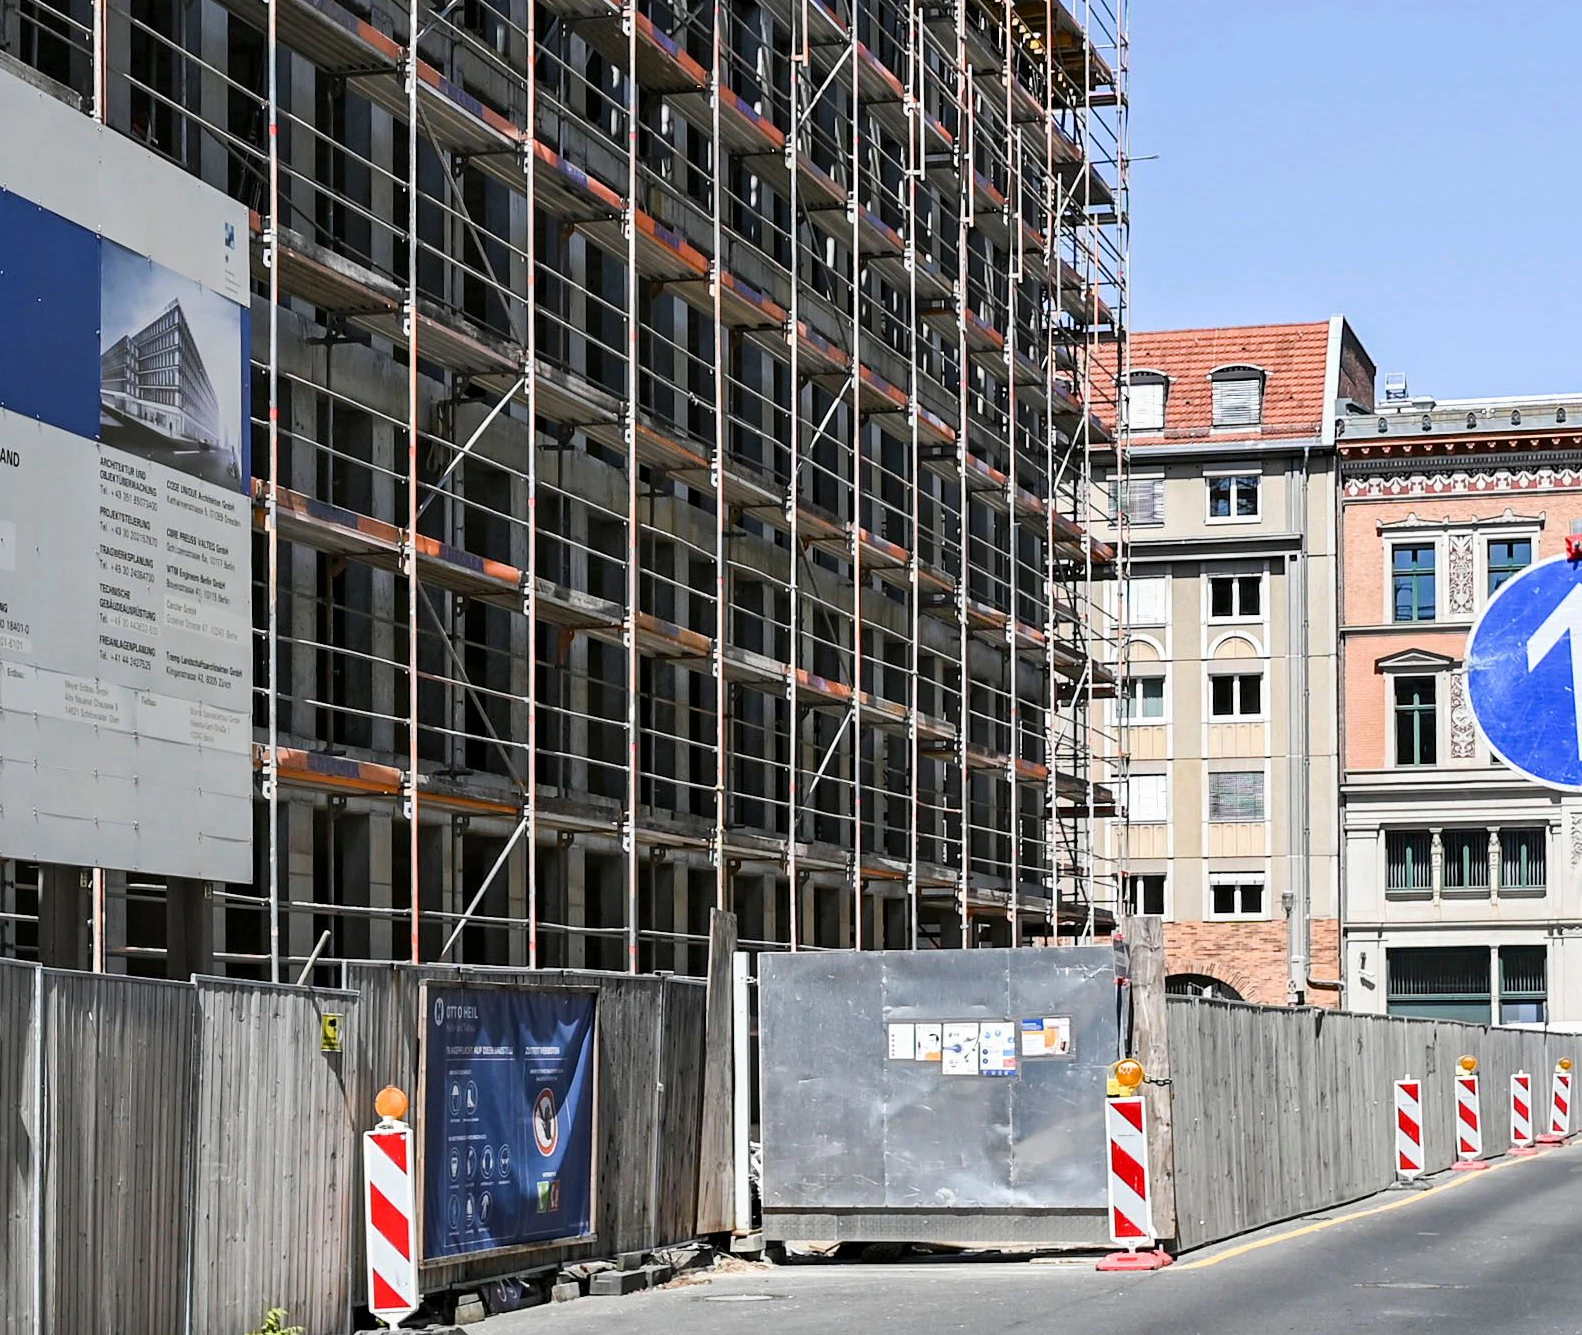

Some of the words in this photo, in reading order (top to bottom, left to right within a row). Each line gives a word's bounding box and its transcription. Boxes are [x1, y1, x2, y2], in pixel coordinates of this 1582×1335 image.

[99, 455, 134, 476] ARCHITEKTUR
[446, 1006, 463, 1019] OTTO
[463, 1006, 479, 1019] HEIL
